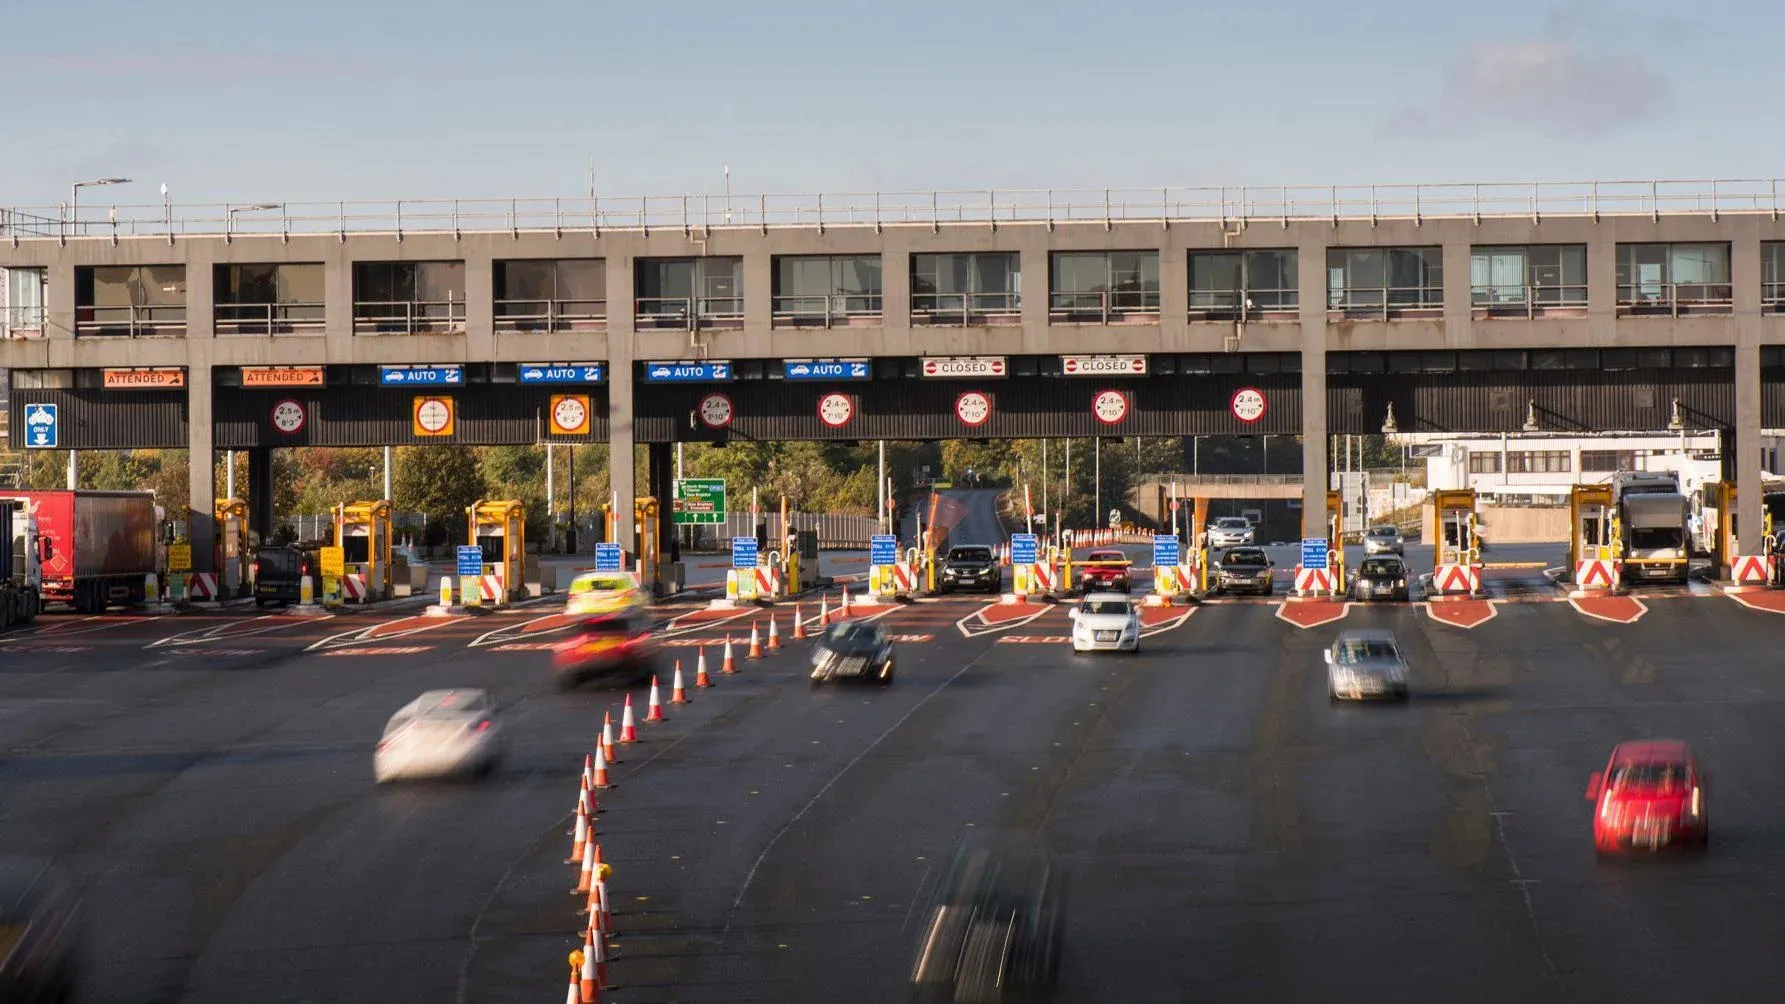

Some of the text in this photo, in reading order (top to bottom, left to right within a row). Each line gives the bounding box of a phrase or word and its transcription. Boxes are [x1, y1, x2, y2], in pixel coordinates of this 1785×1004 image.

[812, 365, 842, 374] AUTO
[942, 364, 986, 372] CLOSED
[1082, 362, 1127, 370] CLOSED
[408, 371, 436, 380] AUTO
[546, 369, 575, 378] AUTO
[674, 368, 703, 376] AUTO
[109, 374, 164, 384] ATTENDED
[248, 373, 304, 382] ATTENDED
